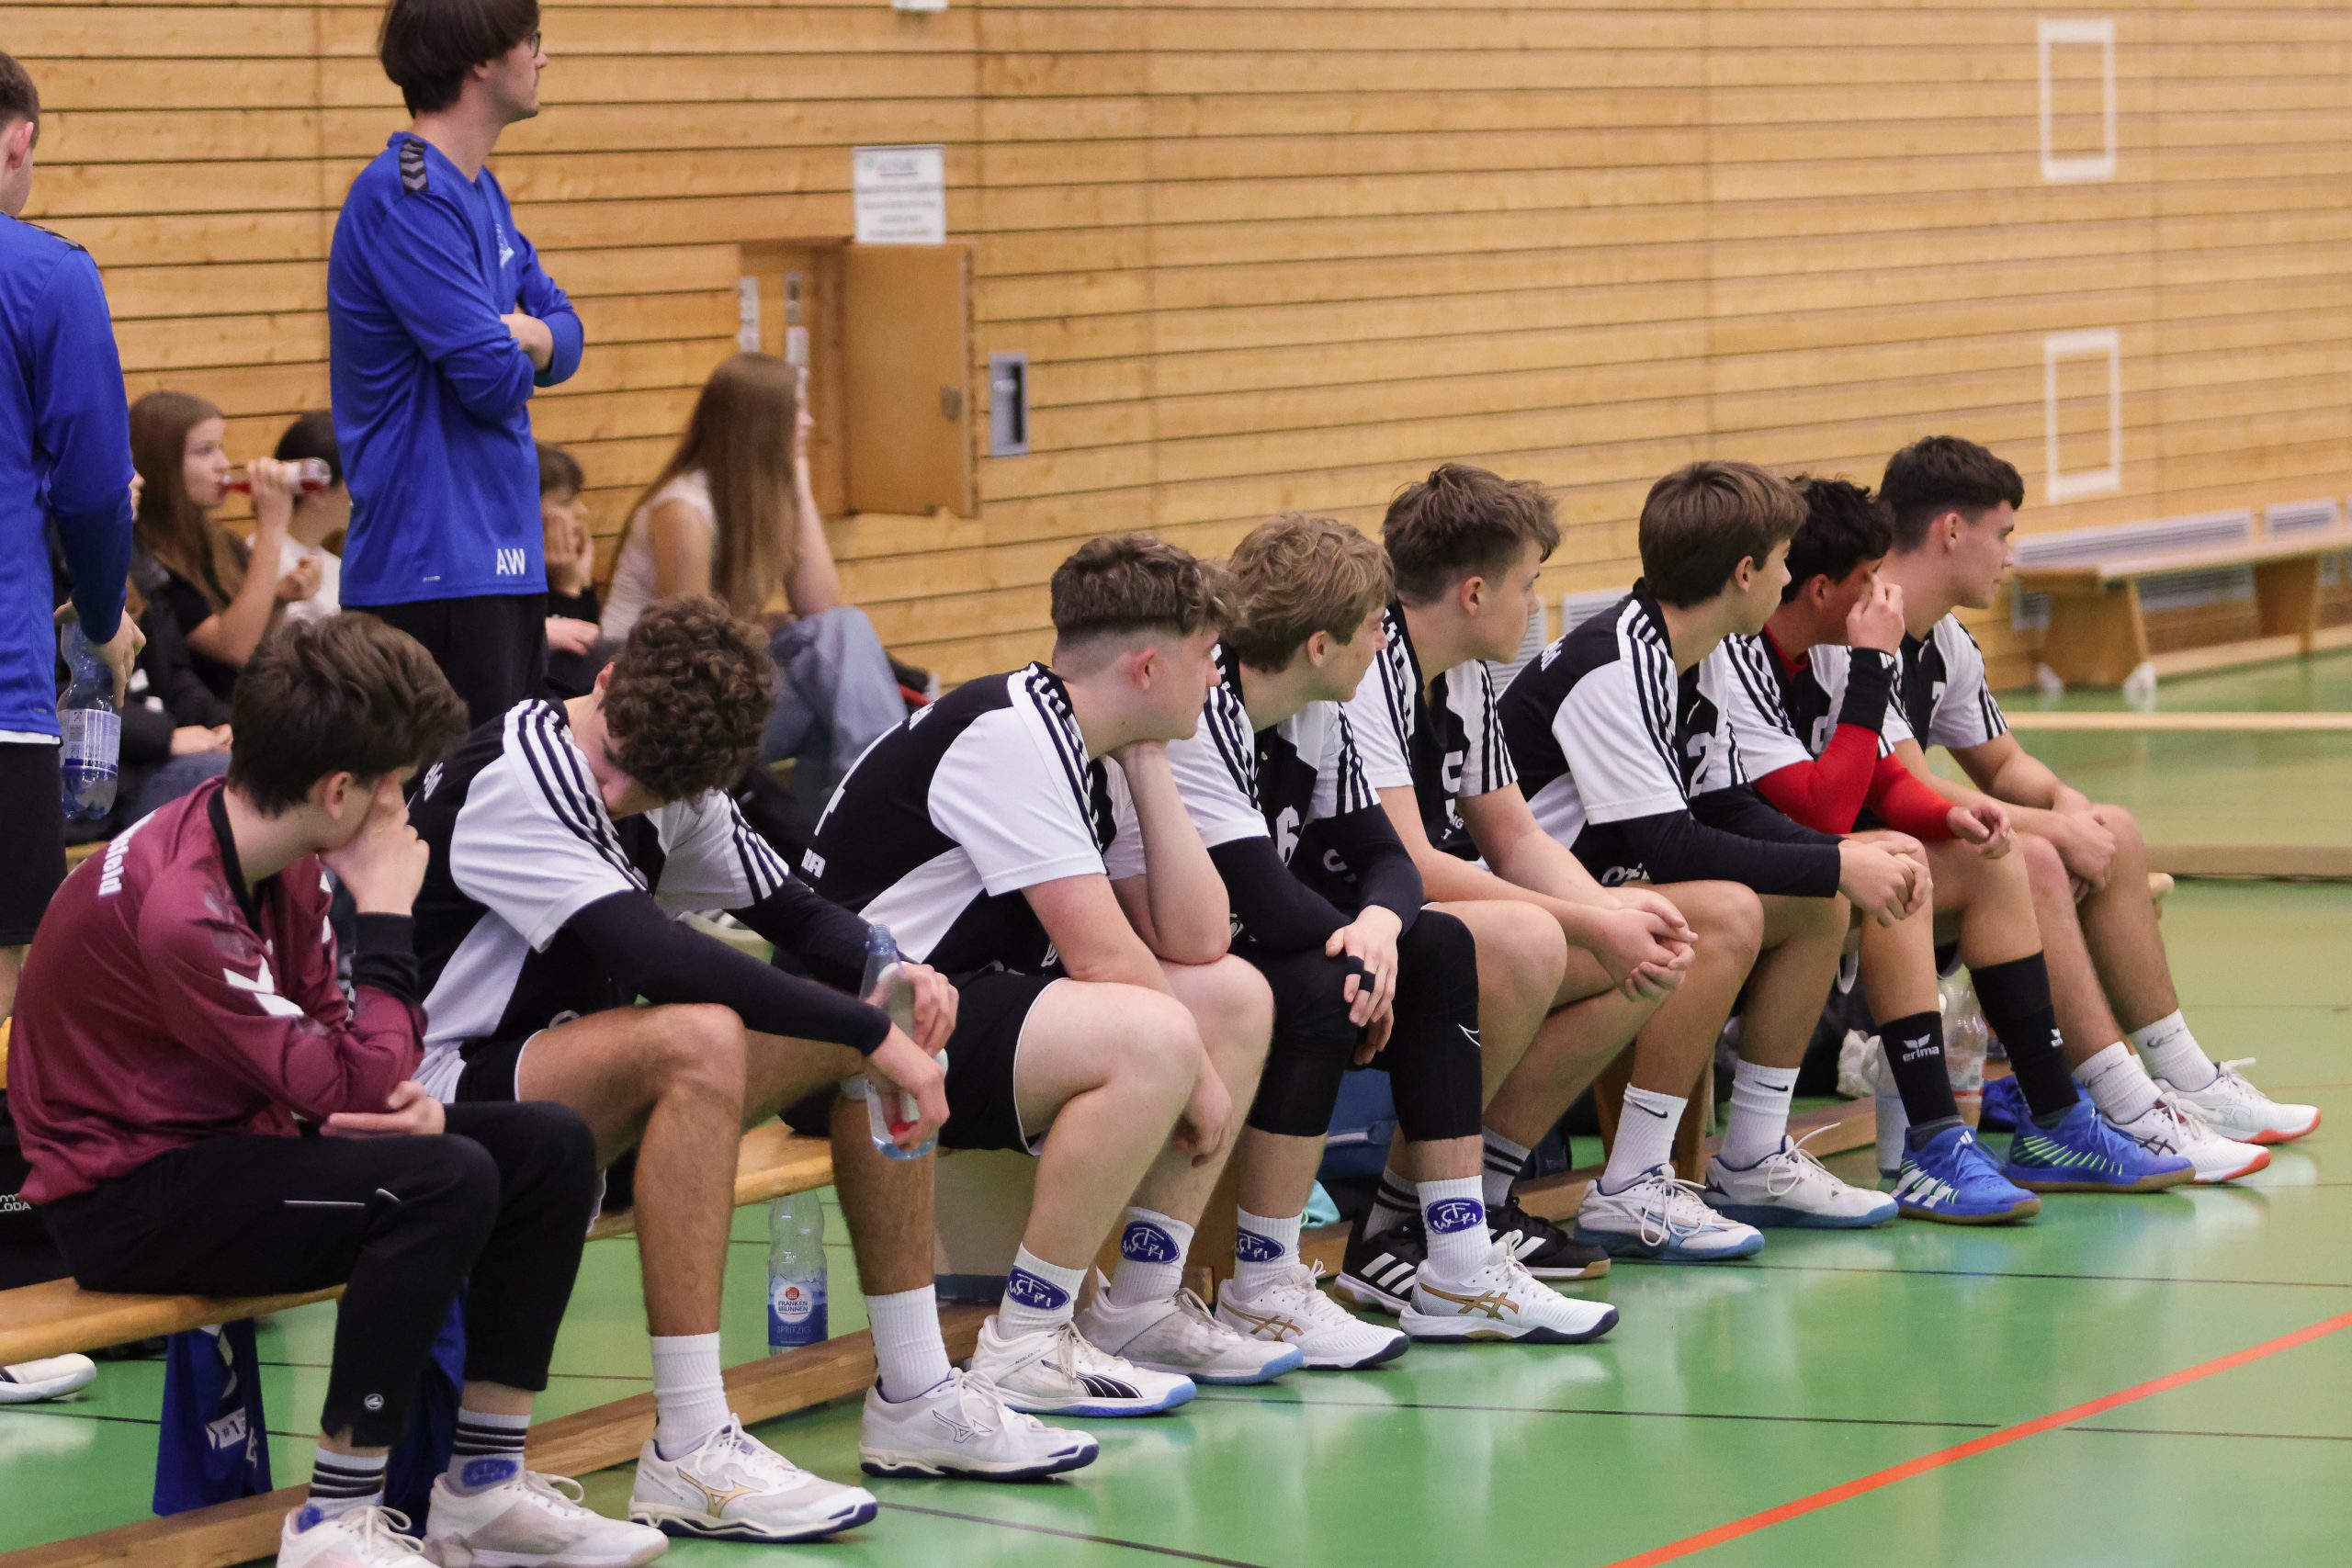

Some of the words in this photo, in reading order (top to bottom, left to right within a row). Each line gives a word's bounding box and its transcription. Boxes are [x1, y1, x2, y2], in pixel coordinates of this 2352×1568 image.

[496, 548, 526, 575] AW
[1276, 805, 1300, 867] 6
[1902, 1046, 1940, 1062] erima
